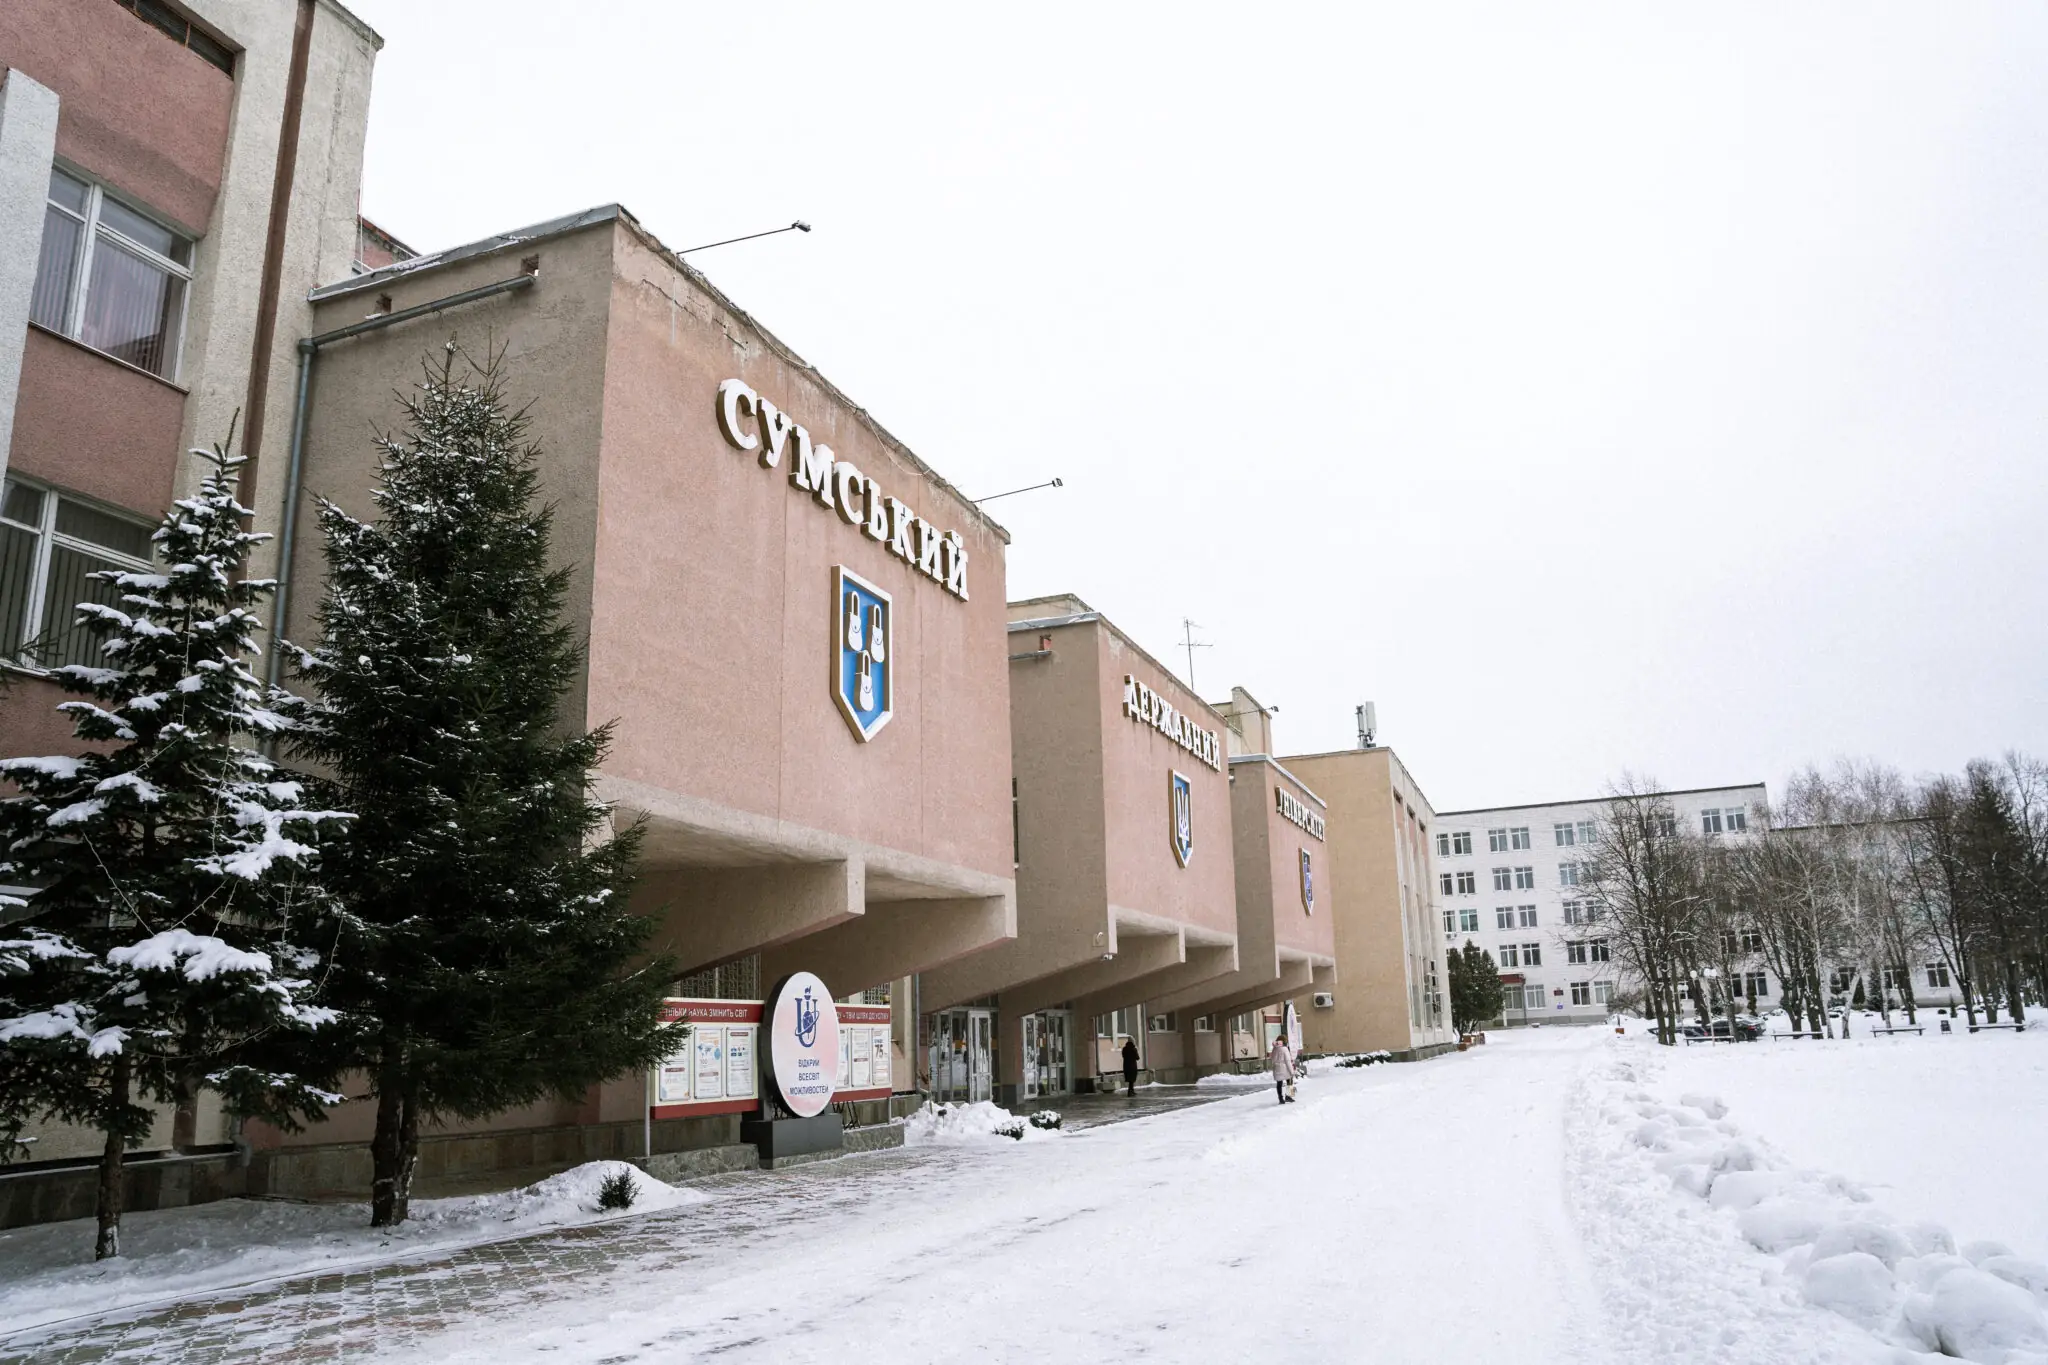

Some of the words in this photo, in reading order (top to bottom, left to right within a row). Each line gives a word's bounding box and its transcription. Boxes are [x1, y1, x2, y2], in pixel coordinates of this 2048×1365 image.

[716, 379, 969, 602] СУМСЬКИЙ
[1123, 674, 1221, 773] ДЕРЖАВНИЙ
[709, 1008, 734, 1017] ЗМІНИТЬ
[734, 1009, 748, 1018] СВІТ
[798, 1072, 820, 1081] ВСЕСВІТ
